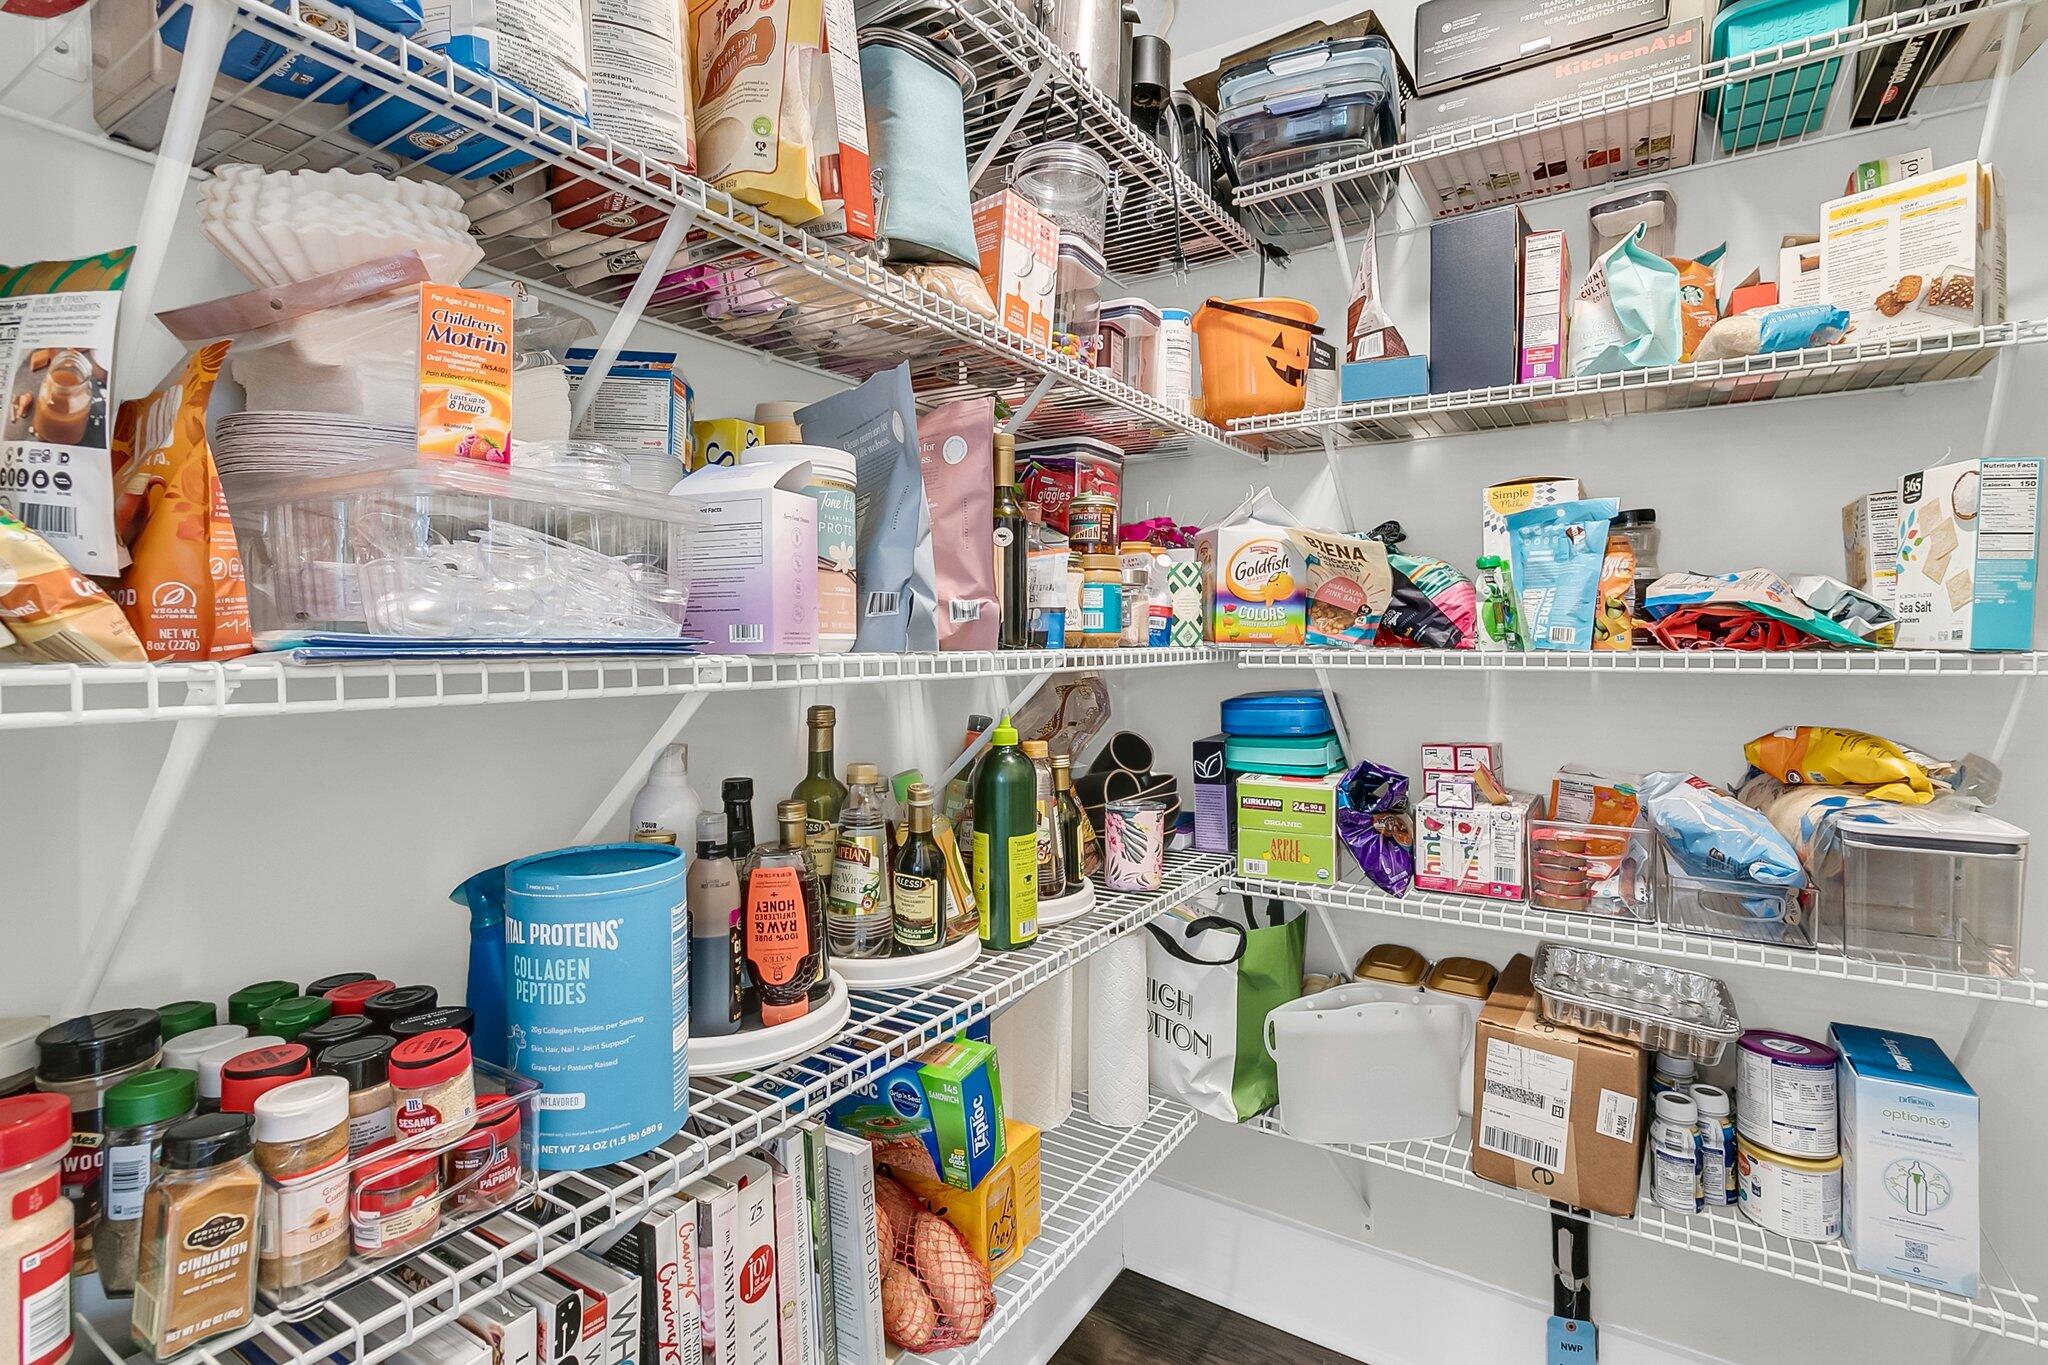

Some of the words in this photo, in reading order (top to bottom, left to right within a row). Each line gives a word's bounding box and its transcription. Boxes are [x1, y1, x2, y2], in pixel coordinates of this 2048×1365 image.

[1567, 6, 1615, 26] ALIMENTOS
[1555, 28, 1693, 79] KitchenAid
[1609, 71, 1624, 81] WITH
[1659, 59, 1674, 68] AND
[1674, 54, 1691, 64] SLICE
[1679, 62, 1692, 70] LES
[592, 71, 634, 83] INGREDIENTS:
[592, 78, 607, 86] 100%
[607, 80, 620, 88] Hard
[621, 82, 632, 90] Red
[430, 293, 442, 302] For
[442, 295, 462, 307] Ages
[469, 300, 476, 308] to
[486, 305, 506, 316] Years
[431, 309, 504, 335] Children's
[425, 323, 508, 356] Motrin
[426, 354, 442, 363] Oral
[442, 356, 481, 368] Suspension
[481, 363, 509, 374] (NSAID)
[451, 352, 487, 363] Ibuprofen
[425, 370, 439, 378] Pain
[484, 378, 508, 389] Reducer
[449, 393, 468, 401] Lasts
[448, 400, 456, 410] 8
[457, 401, 485, 414] hours
[443, 422, 461, 430] Alcohol
[924, 442, 936, 452] for
[1904, 477, 1921, 495] 365
[1037, 488, 1071, 504] giggles
[1492, 488, 1529, 501] Simple
[1303, 535, 1368, 563] BIENA
[1235, 554, 1289, 580] Goldfish
[1317, 551, 1365, 568] CHICKPEA
[1323, 560, 1361, 573] SNACKS
[1324, 588, 1342, 600] PINK
[1344, 593, 1362, 604] SALT
[1327, 582, 1364, 598] HIMALAYAN
[1239, 606, 1287, 621] COLORS
[1534, 586, 1559, 642] UNREAL
[1899, 602, 1913, 614] Sea
[1914, 600, 1932, 613] Salt
[159, 628, 178, 639] NET
[181, 629, 200, 640] WT.
[146, 640, 166, 651] 8oz
[168, 639, 201, 652] (227g)
[1242, 797, 1282, 807] KIRKLAND
[641, 821, 657, 829] YOUR
[1264, 818, 1303, 828] ORGANIC
[1271, 838, 1300, 850] APPLE
[1271, 849, 1301, 863] SAUCE
[1423, 833, 1442, 876] hint
[896, 876, 923, 888] ALESSI
[755, 899, 795, 912] HONEY
[755, 912, 797, 920] UNFILTERED
[529, 917, 618, 950] PROTEINS
[755, 921, 765, 934] &
[767, 920, 797, 934] RAW
[755, 934, 773, 942] PURE
[776, 933, 799, 942] 100%
[763, 954, 792, 963] NATE'S
[514, 954, 590, 981] COLLAGEN
[516, 980, 587, 1005] PEPTIDES
[530, 1025, 542, 1034] 20g
[542, 1025, 573, 1036] Collagen
[573, 1022, 604, 1035] Peptides
[605, 1021, 618, 1031] per
[619, 1015, 644, 1030] Serving
[530, 1043, 545, 1054] Skin,
[545, 1045, 559, 1055] Hair,
[560, 1044, 575, 1053] Nail
[582, 1042, 601, 1053] Joint
[530, 1063, 549, 1072] Grass
[549, 1063, 561, 1072] Fed
[567, 1061, 593, 1072] Pasture
[594, 1058, 618, 1069] Raised
[943, 1083, 959, 1095] 145
[907, 1094, 922, 1104] Seal
[928, 1090, 960, 1105] SANDWICH
[399, 1115, 437, 1128] SESAME
[972, 1094, 989, 1155] Ziploc
[1882, 1109, 1936, 1126] options
[541, 1144, 560, 1154] NET
[560, 1143, 576, 1154] WT
[578, 1142, 591, 1152] 24
[592, 1139, 607, 1150] OZ
[609, 1136, 626, 1149] (1.5
[627, 1131, 640, 1144] lb)
[641, 1125, 656, 1139] 680
[1896, 1133, 1933, 1144] sustainable
[1933, 1140, 1954, 1148] world.
[816, 1147, 824, 1170] ALEX
[948, 1158, 966, 1167] GUIDE
[950, 1153, 965, 1161] EASY
[479, 1167, 516, 1190] PAPRIKA
[488, 1164, 510, 1178] SMOKED
[749, 1198, 764, 1222] 75
[795, 1171, 807, 1246] comfortable
[817, 1173, 829, 1247] SNODGRASS
[862, 1180, 877, 1256] DEFINED
[191, 1224, 240, 1244] SELECTION
[194, 1219, 239, 1239] PRIVATE
[178, 1240, 249, 1275] CINNAMON
[193, 1259, 232, 1280] GROUND
[744, 1248, 771, 1301] joy
[798, 1247, 807, 1287] kitchen
[821, 1257, 831, 1309] dinner
[867, 1258, 880, 1304] DISH
[800, 1299, 808, 1319] alex
[583, 1315, 606, 1331] MELISSA
[165, 1329, 181, 1344] NET
[182, 1324, 195, 1337] WT
[753, 1336, 767, 1351] BECKER
[1561, 1341, 1583, 1353] NWP
